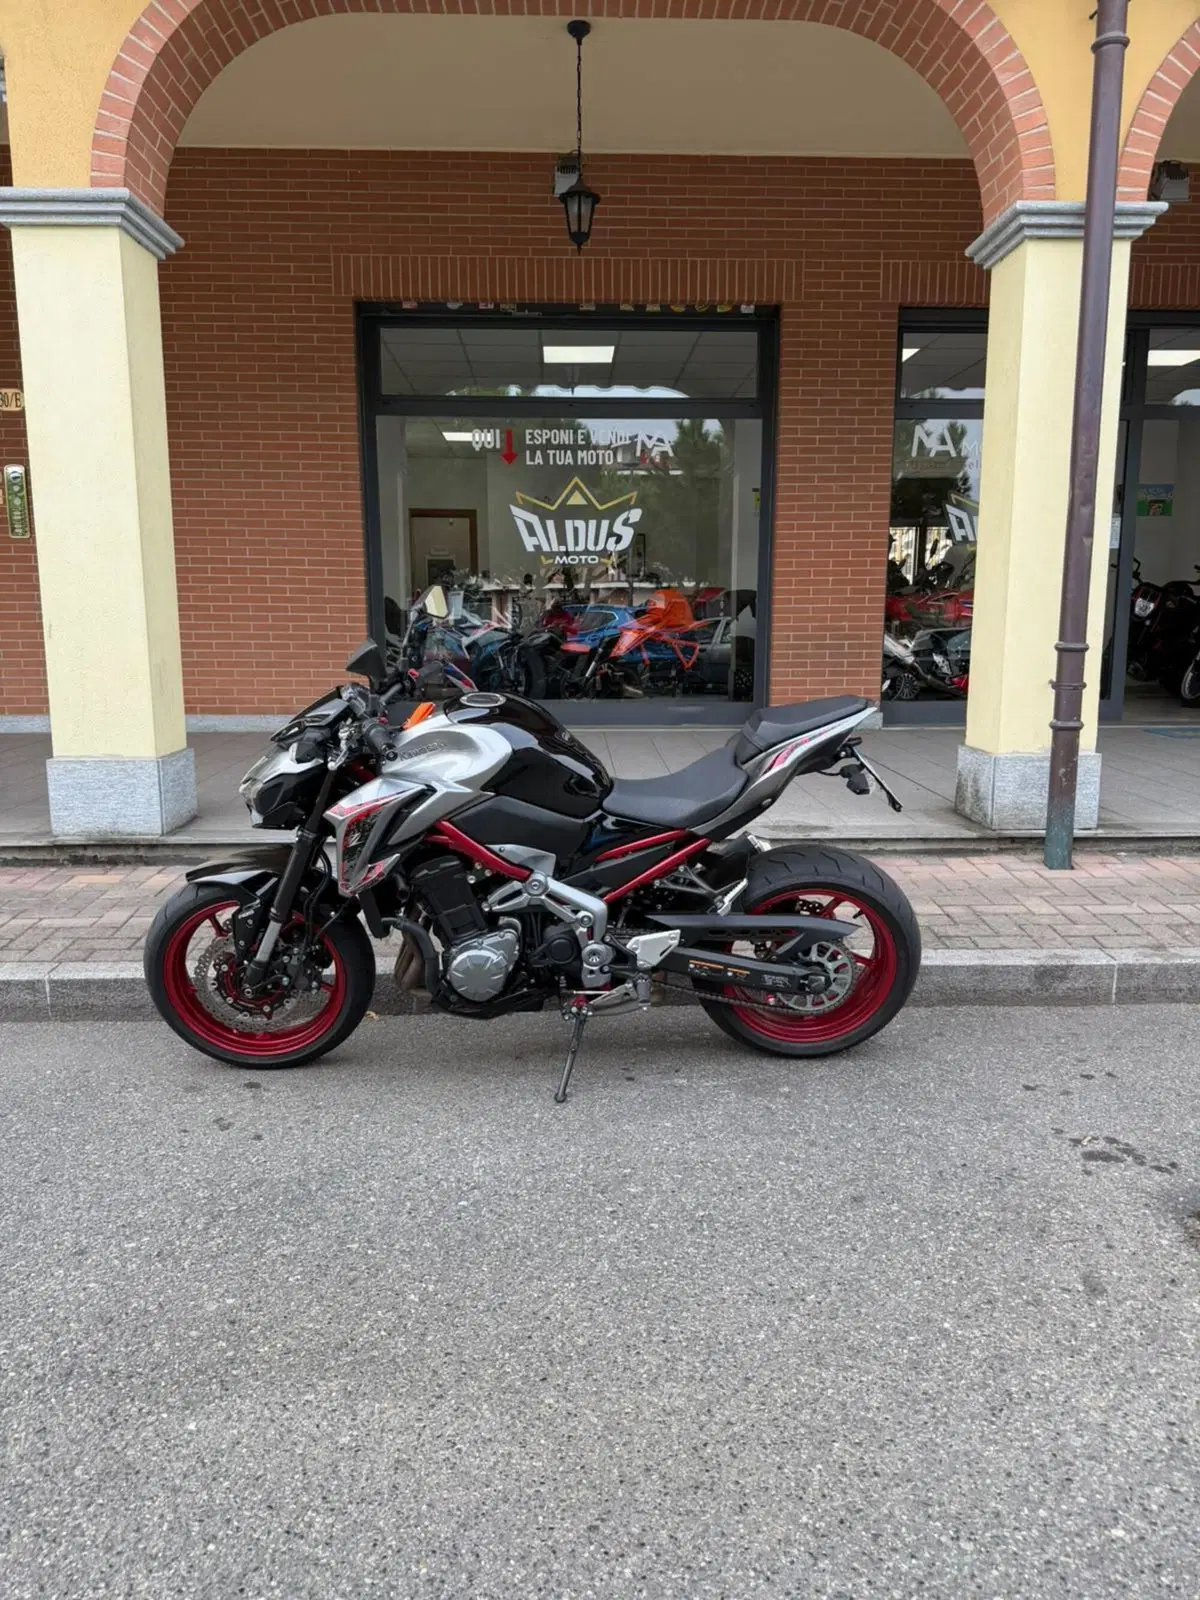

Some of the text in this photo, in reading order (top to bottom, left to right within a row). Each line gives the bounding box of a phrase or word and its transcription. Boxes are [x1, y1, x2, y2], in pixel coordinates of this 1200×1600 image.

[472, 428, 500, 451] QUI
[525, 429, 630, 445] ESPONI E VENDI
[525, 450, 614, 465] LA TUA MOTO
[509, 504, 643, 552] ALDUS
[554, 555, 600, 565] MOTO
